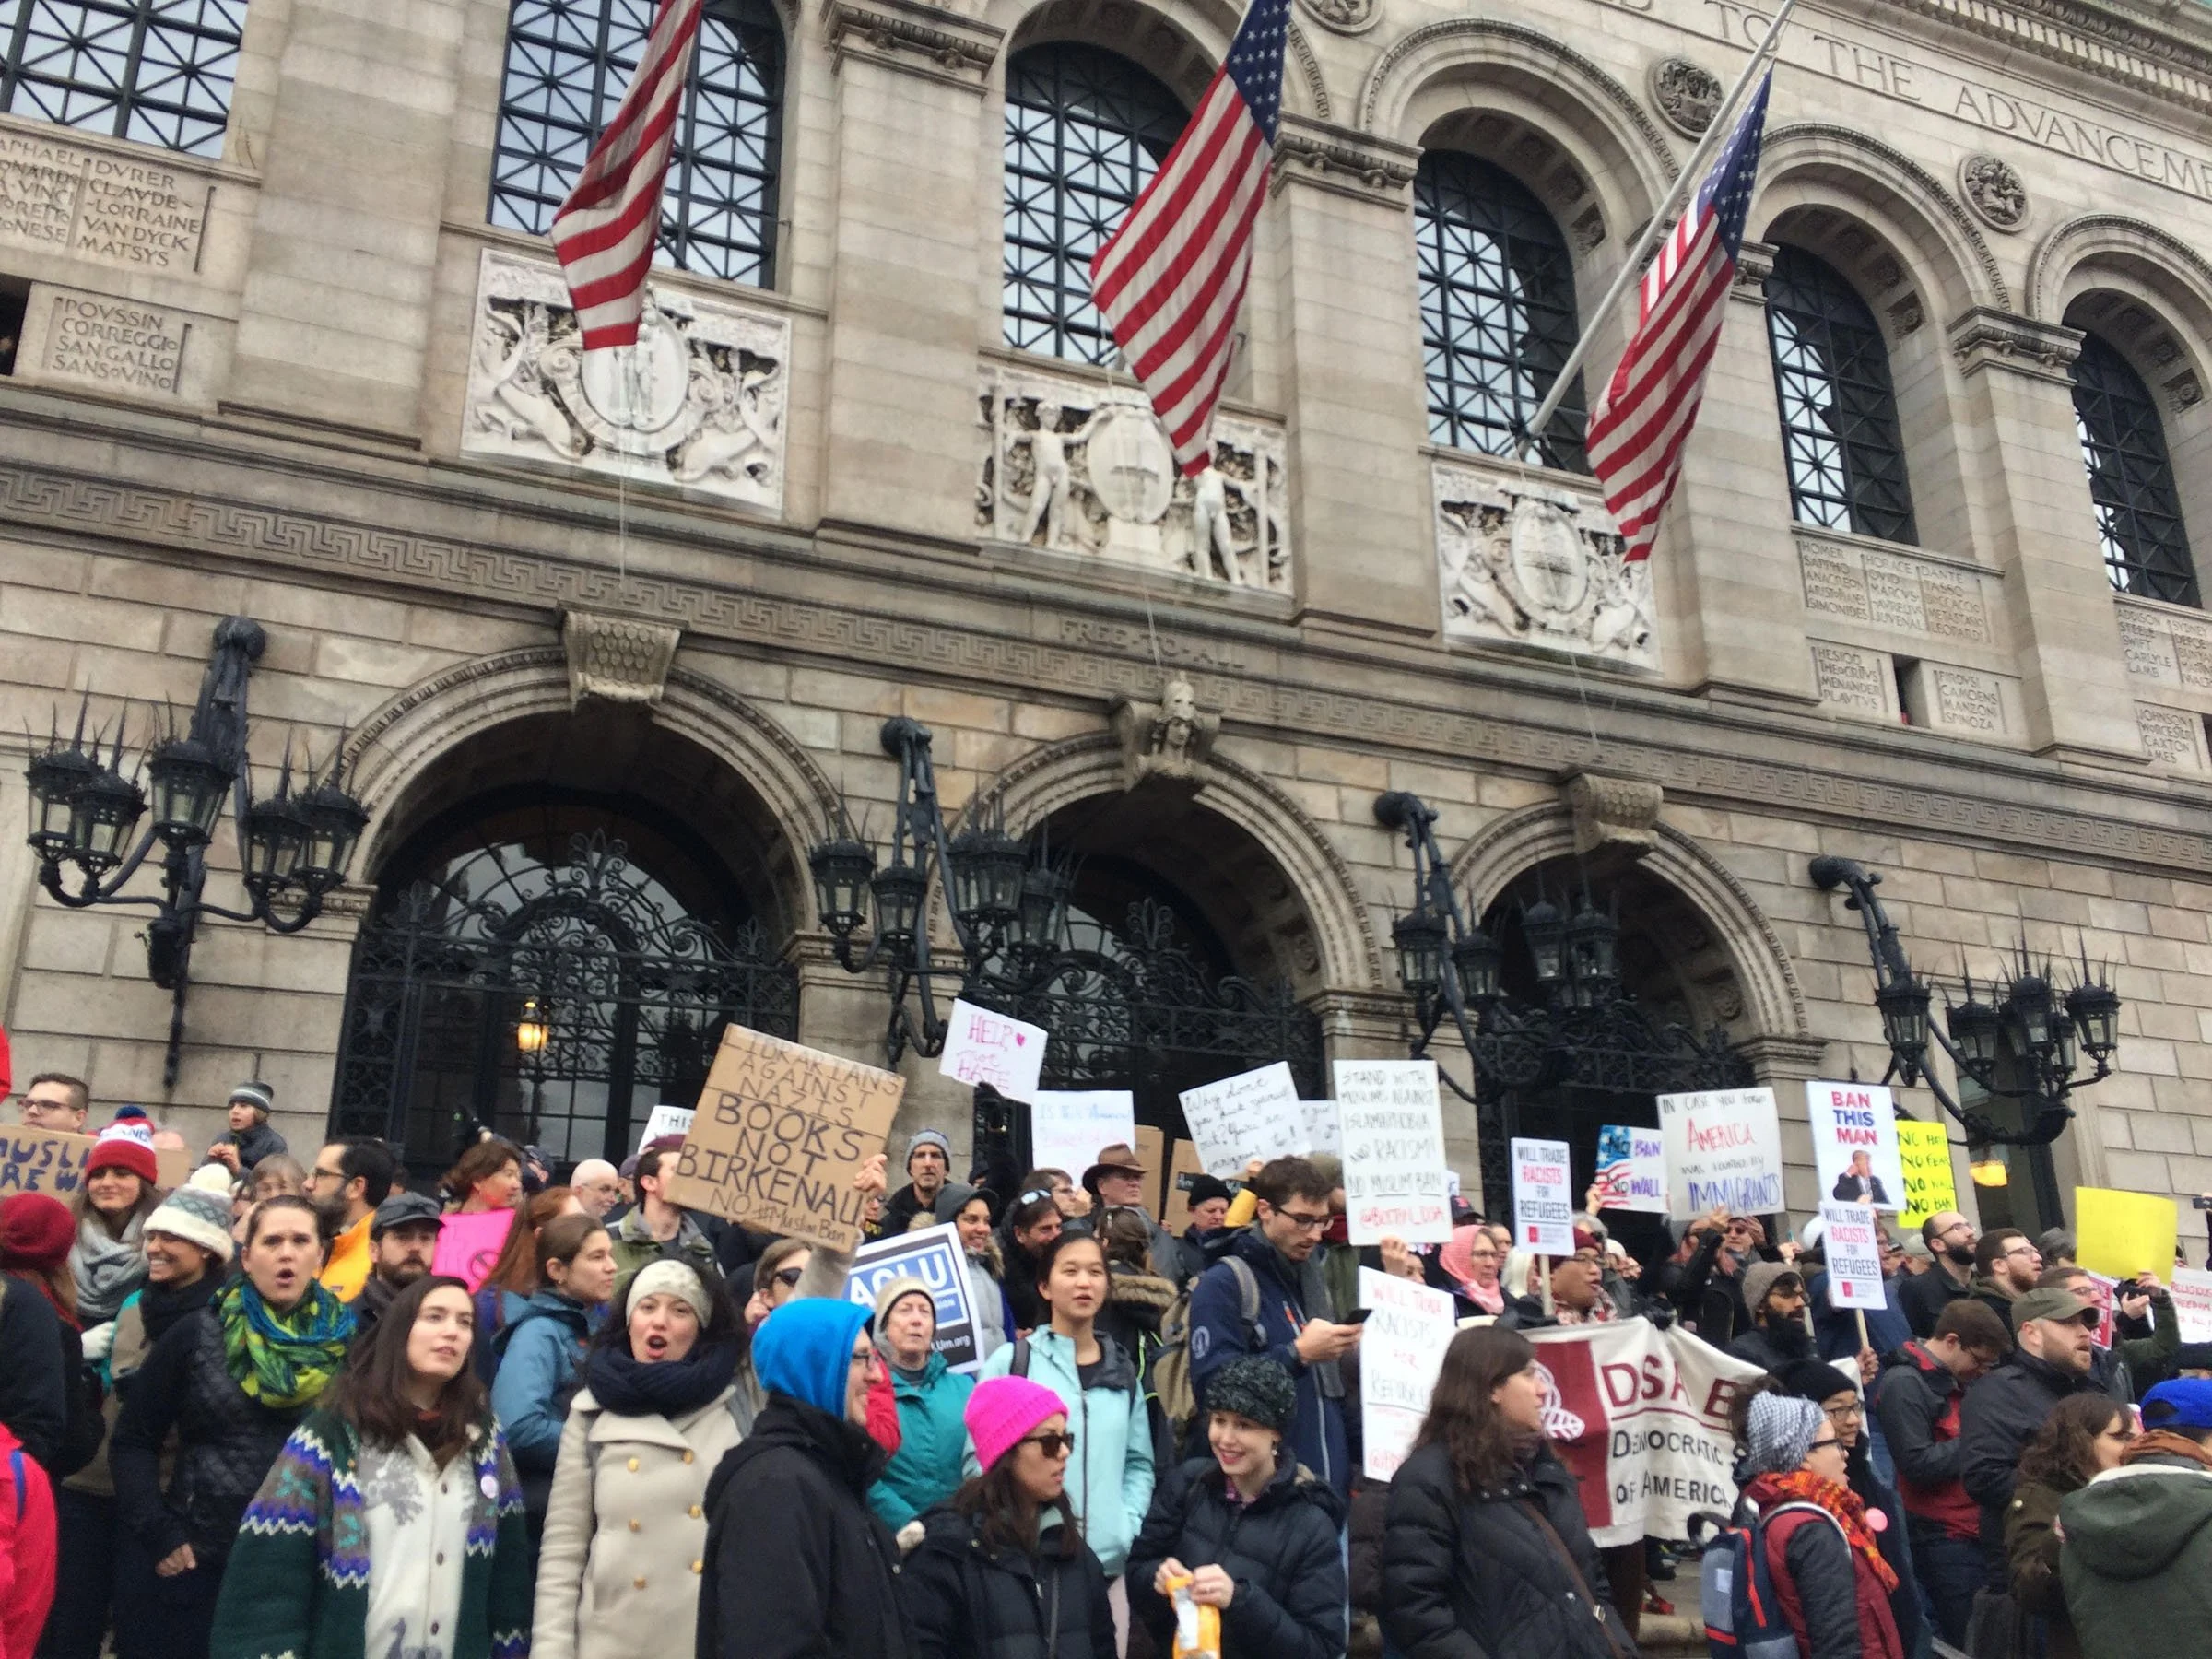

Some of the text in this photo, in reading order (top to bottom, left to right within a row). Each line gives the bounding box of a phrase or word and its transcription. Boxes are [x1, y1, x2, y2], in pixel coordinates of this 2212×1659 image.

[1813, 34, 1921, 102] THE
[95, 160, 174, 190] DVRER
[83, 215, 190, 252] VAN DYCK
[77, 235, 170, 266] MATSYS
[65, 299, 163, 331] POVSSIN
[61, 317, 179, 351] CORREGGIO
[1802, 541, 1844, 559] HOMER
[1920, 565, 1963, 584] DANTE
[1924, 579, 1963, 597] TASSO
[1818, 647, 1862, 665] HESIOD
[738, 1053, 875, 1110] AGAINST
[739, 1076, 854, 1129] NAZIS
[1662, 1098, 1676, 1114] IN
[1685, 1096, 1711, 1111] CASE
[1831, 1091, 1871, 1108] BAN
[714, 1093, 865, 1162] BOOKS
[1832, 1109, 1875, 1127] THIS
[1836, 1127, 1878, 1146] MAN
[1897, 1130, 1919, 1147] NO
[735, 1126, 828, 1176] NOT
[1517, 1147, 1566, 1164] WILL TRADE
[1635, 1139, 1662, 1157] BAN
[1900, 1153, 1924, 1169] NO
[1523, 1164, 1563, 1185] RACISTS
[676, 1143, 865, 1228] BIRKENAU
[1535, 1185, 1550, 1198] FOR
[1630, 1176, 1661, 1198] WALL
[1687, 1171, 1780, 1213] IMMIGRANTS
[1902, 1177, 1926, 1194] NO
[708, 1186, 751, 1216] NO
[1519, 1200, 1570, 1221] REFUGEES
[1904, 1197, 1929, 1216] NO
[1824, 1208, 1871, 1225] WILL TRADE
[1830, 1225, 1870, 1244] RACISTS
[1845, 1244, 1859, 1255] FOR
[1831, 1257, 1878, 1277] REFUGEES
[1600, 1354, 1692, 1408] DSA
[1612, 1430, 1724, 1467] DEMOCRATIC
[1616, 1482, 1635, 1504] OF
